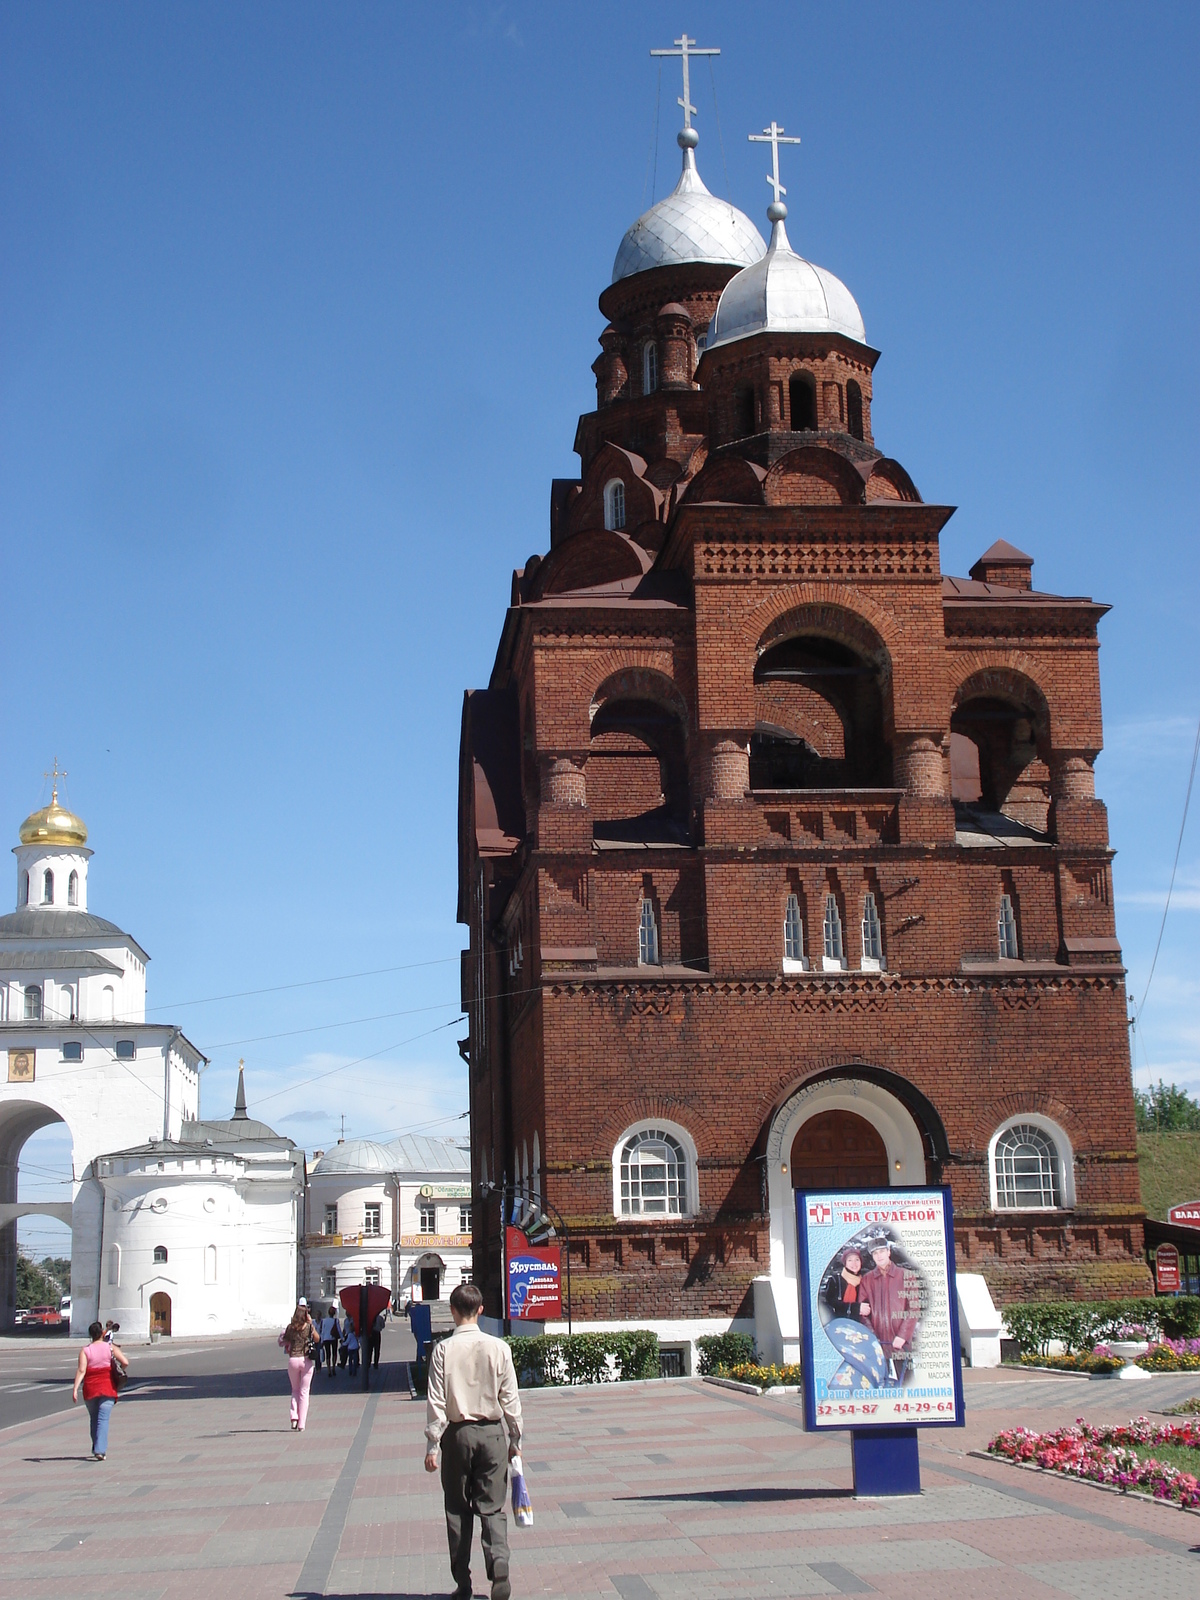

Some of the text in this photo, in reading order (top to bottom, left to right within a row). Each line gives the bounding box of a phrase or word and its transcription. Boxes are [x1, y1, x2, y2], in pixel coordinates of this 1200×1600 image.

[837, 1208, 942, 1222] "НА СТУДЕНОЙ"
[1175, 1210, 1200, 1219] ВЛАД
[900, 1229, 942, 1238] СТОМАТОЛОГИЯ
[401, 1236, 462, 1246] ЭКОНОМНЫЙ
[896, 1239, 943, 1248] ПРОТЕЗИРОВАНИЕ
[906, 1249, 944, 1258] ГИНЕКОЛОГИЯ
[509, 1261, 558, 1274] Хрусталь
[917, 1259, 945, 1268] УРОЛОГИЯ
[924, 1320, 948, 1329] ТЕРАПИЯ
[918, 1330, 949, 1339] ПЕДИАТРИЯ
[908, 1361, 950, 1370] ПСИХОТЕРАПИЯ
[927, 1371, 951, 1380] МАССАЖ
[816, 1377, 953, 1400] Ваша семейная клиника
[817, 1402, 953, 1415] 32-54-87 44-29-64
